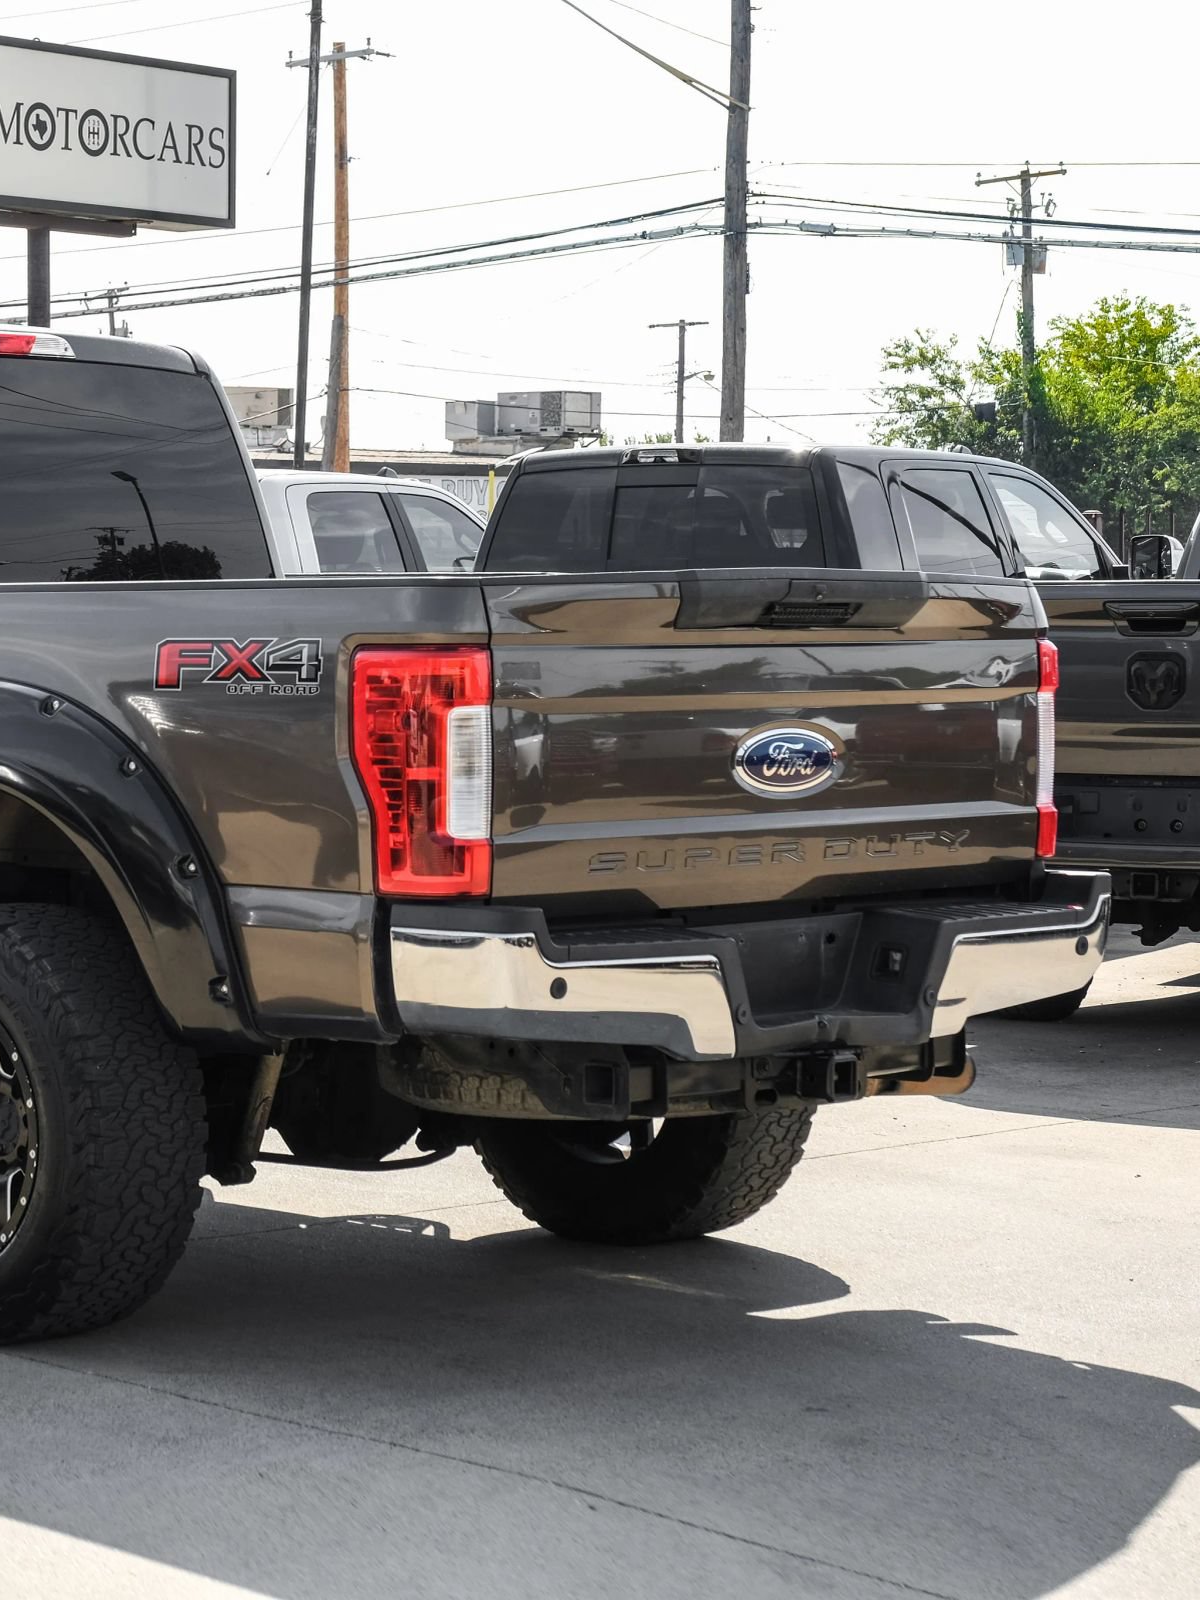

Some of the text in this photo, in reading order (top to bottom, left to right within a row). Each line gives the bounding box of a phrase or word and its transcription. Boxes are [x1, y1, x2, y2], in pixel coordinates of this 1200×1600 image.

[441, 479, 489, 506] BUY
[154, 638, 323, 691] FX4
[226, 684, 320, 695] OFF ROAD
[762, 741, 816, 778] Ford
[586, 828, 971, 875] SUPER DUTY
